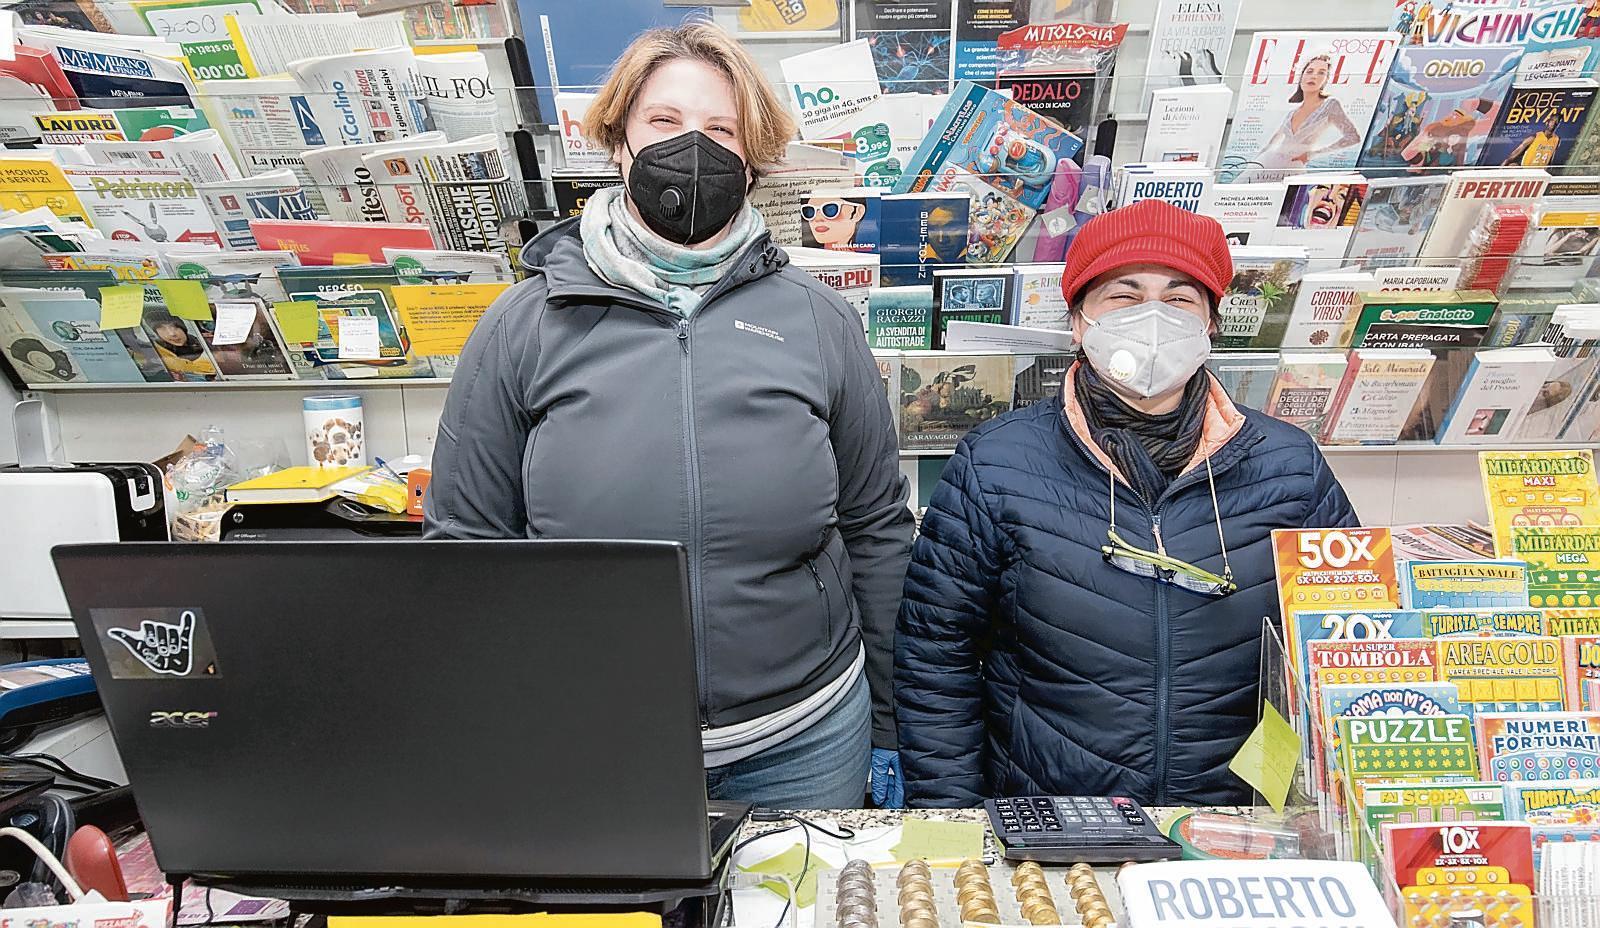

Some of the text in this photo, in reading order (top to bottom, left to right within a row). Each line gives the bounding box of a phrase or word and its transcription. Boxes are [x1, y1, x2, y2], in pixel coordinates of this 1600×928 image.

[1178, 3, 1221, 13] ELENA
[1171, 14, 1223, 22] FERRANTE
[1427, 7, 1585, 43] VICHINGHI
[1023, 24, 1116, 42] MITOLOGIA
[1329, 38, 1378, 54] SPOSE
[115, 67, 151, 77] FINANZA
[1424, 60, 1484, 78] ODINO
[422, 75, 449, 99] IL
[378, 68, 408, 127] giorni decisivi
[794, 83, 840, 110] ho.
[1512, 92, 1566, 108] KOBE
[332, 80, 359, 137] Carlino
[802, 110, 813, 119] 50
[814, 105, 832, 117] giga
[832, 103, 840, 111] in
[856, 96, 872, 104] sms
[1164, 104, 1195, 113] Lezioni
[1505, 107, 1585, 124] BRYANT
[34, 115, 117, 132] LAVORO
[804, 115, 829, 127] minuti
[1162, 113, 1172, 121] di
[566, 139, 582, 149] 70
[250, 154, 305, 169] La prima
[1533, 152, 1548, 164] 24
[8, 176, 52, 184] SERVIZI
[89, 176, 198, 199] Patrimoni
[1133, 181, 1204, 198] ROBERTO
[1460, 180, 1545, 199] PERTINI
[449, 185, 485, 248] TASCHE
[917, 211, 929, 279] BEETHOVEN
[844, 268, 873, 287] PIÙ
[1382, 277, 1449, 285] MARIA CAPOBIANCHI
[1310, 291, 1355, 306] CORONA
[876, 308, 927, 316] GIORGIO
[876, 315, 925, 323] RAGAZZI
[1312, 306, 1345, 321] VIRUS
[1380, 309, 1474, 322] SuperEnalotto
[876, 327, 926, 337] LA SVENDITA DI
[1364, 333, 1461, 342] CARTA PREPAGATA
[876, 336, 925, 347] AUTOSTRADE
[1279, 395, 1328, 403] DEGLI DEI
[1281, 408, 1317, 416] GRECI
[907, 433, 958, 441] CARAVAGGIO
[1486, 457, 1590, 476] MILIARDARIO
[1523, 476, 1556, 487] MAXI
[1296, 530, 1376, 569] 50X
[1555, 553, 1589, 565] MEGA
[1418, 568, 1518, 579] BATTAGLIA NAVALE
[1321, 613, 1395, 640] 20X
[1429, 613, 1479, 637] TURISTA
[1493, 613, 1543, 636] SEMPRE
[1352, 643, 1396, 652] LA SUPER
[1445, 641, 1559, 666] AREA GOLD
[1317, 649, 1433, 668] TOMBOLA
[149, 710, 218, 729] acer
[1506, 720, 1588, 734] NUMERI
[1350, 719, 1466, 744] PUZZLE
[1402, 789, 1471, 806] SCOPA
[1522, 789, 1573, 813] TURISTA
[1439, 826, 1481, 854] 10X
[1147, 875, 1358, 922] ROBERTO
